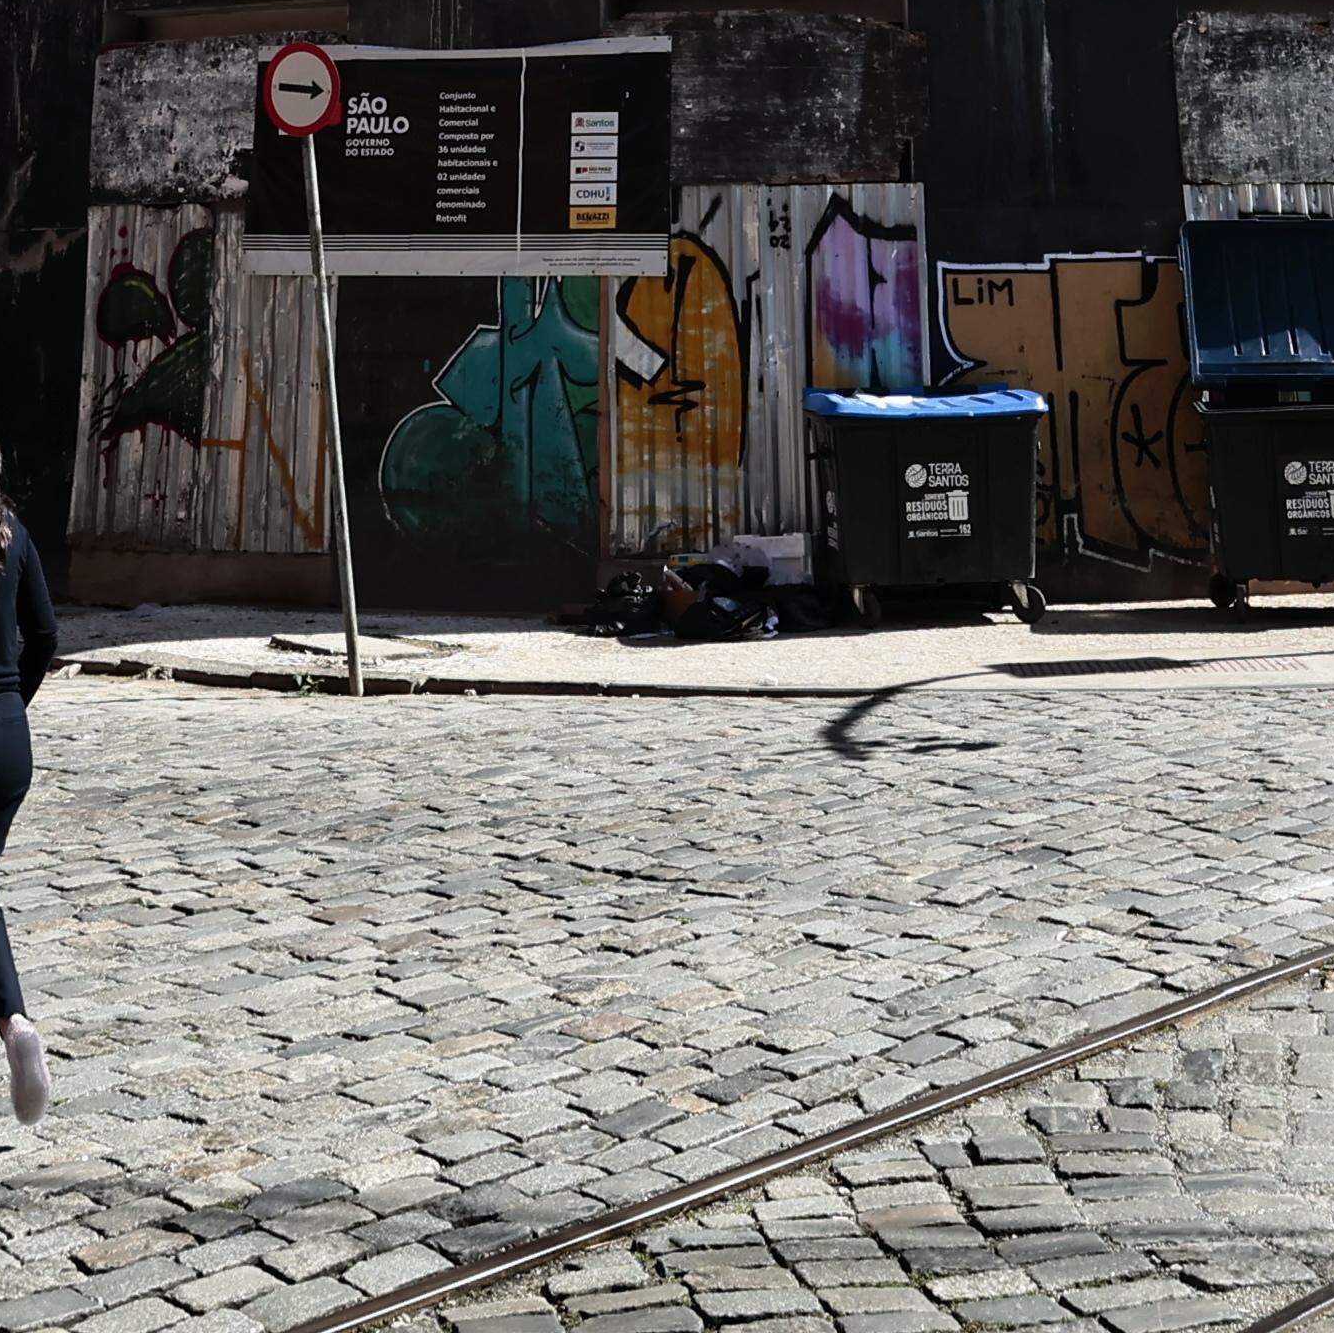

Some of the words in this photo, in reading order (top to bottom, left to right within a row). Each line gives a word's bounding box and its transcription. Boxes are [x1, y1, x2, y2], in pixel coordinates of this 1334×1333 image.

[439, 91, 477, 102] Conjunto
[347, 92, 388, 115] SÃO
[439, 104, 490, 114] Habitacional
[346, 116, 410, 134] PAULO
[438, 118, 479, 127] Comercial
[585, 119, 615, 127] Santos
[438, 132, 479, 141] Composto
[480, 133, 495, 141] por
[345, 138, 391, 148] GOVERNO
[345, 148, 359, 157] DO
[360, 148, 395, 157] ESTADO
[437, 145, 449, 154] 36
[450, 145, 487, 154] unidades
[437, 159, 491, 168] habitacionais
[436, 172, 448, 181] 02
[449, 172, 486, 181] unidades
[436, 186, 480, 195] comerciais
[575, 189, 605, 199] CDHU
[435, 200, 487, 209] denominado
[435, 214, 468, 223] Retrofit
[928, 462, 962, 475] TERRA
[928, 474, 970, 487] SANTOS
[905, 499, 948, 512] RESÍDUOS
[1286, 497, 1329, 510] RESÍDUOS
[906, 511, 948, 522] ORGÂNICOS
[1287, 508, 1331, 519] ORGÂNICOS
[959, 523, 971, 534] 162
